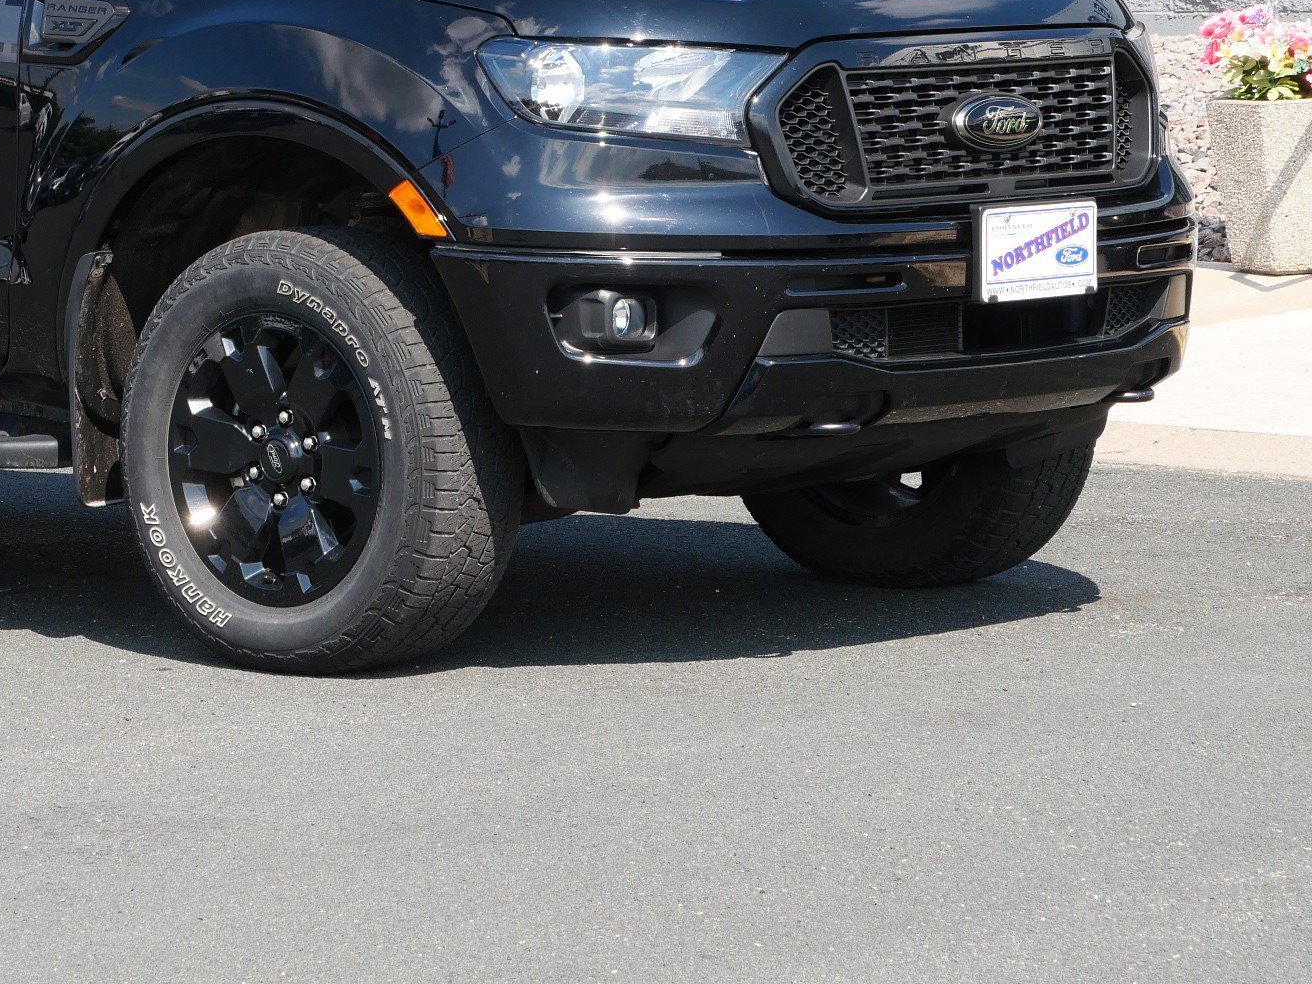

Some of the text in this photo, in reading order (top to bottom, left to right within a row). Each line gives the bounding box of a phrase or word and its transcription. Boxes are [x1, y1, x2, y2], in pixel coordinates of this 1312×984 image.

[46, 3, 108, 15] RANGER
[49, 19, 84, 32] XLT
[982, 105, 1029, 135] Ford
[991, 212, 1090, 276] NORTHFIELD
[1061, 247, 1084, 263] Ford
